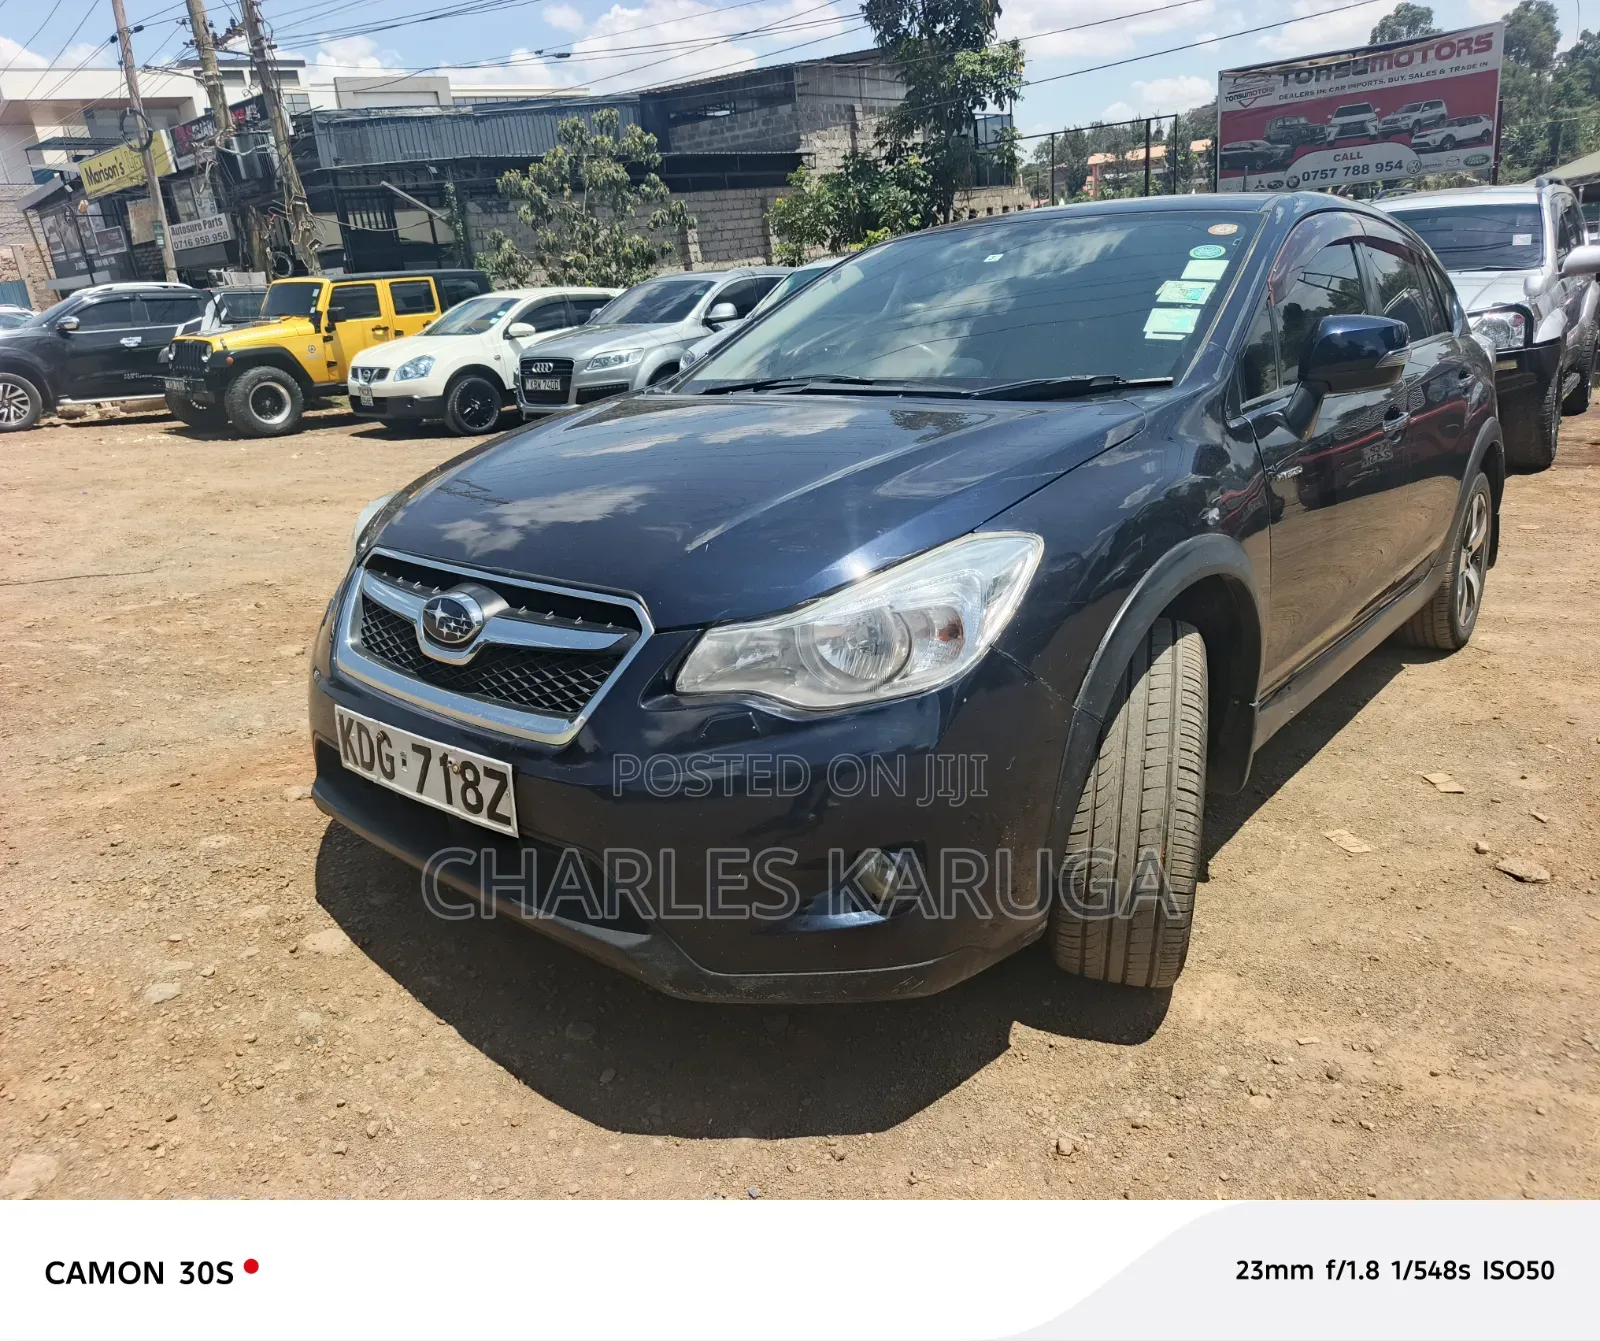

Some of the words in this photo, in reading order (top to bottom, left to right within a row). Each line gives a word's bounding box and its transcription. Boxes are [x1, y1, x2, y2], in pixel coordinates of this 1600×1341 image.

[1279, 90, 1314, 100] DEALERS
[1348, 79, 1385, 90] IMPORTS,
[1388, 75, 1406, 83] BUY,
[1409, 69, 1437, 79] SALES
[1449, 63, 1477, 73] TRADE
[1333, 151, 1363, 162] CALL
[1302, 168, 1338, 181] 0757
[1343, 164, 1370, 176] 788
[1375, 160, 1403, 173] 954
[171, 222, 203, 236] Autosure
[203, 217, 223, 229] Parts
[173, 238, 193, 250] 0716
[194, 235, 211, 246] 958
[212, 231, 229, 242] 958
[338, 714, 396, 780] KDG
[411, 743, 512, 826] 718Z
